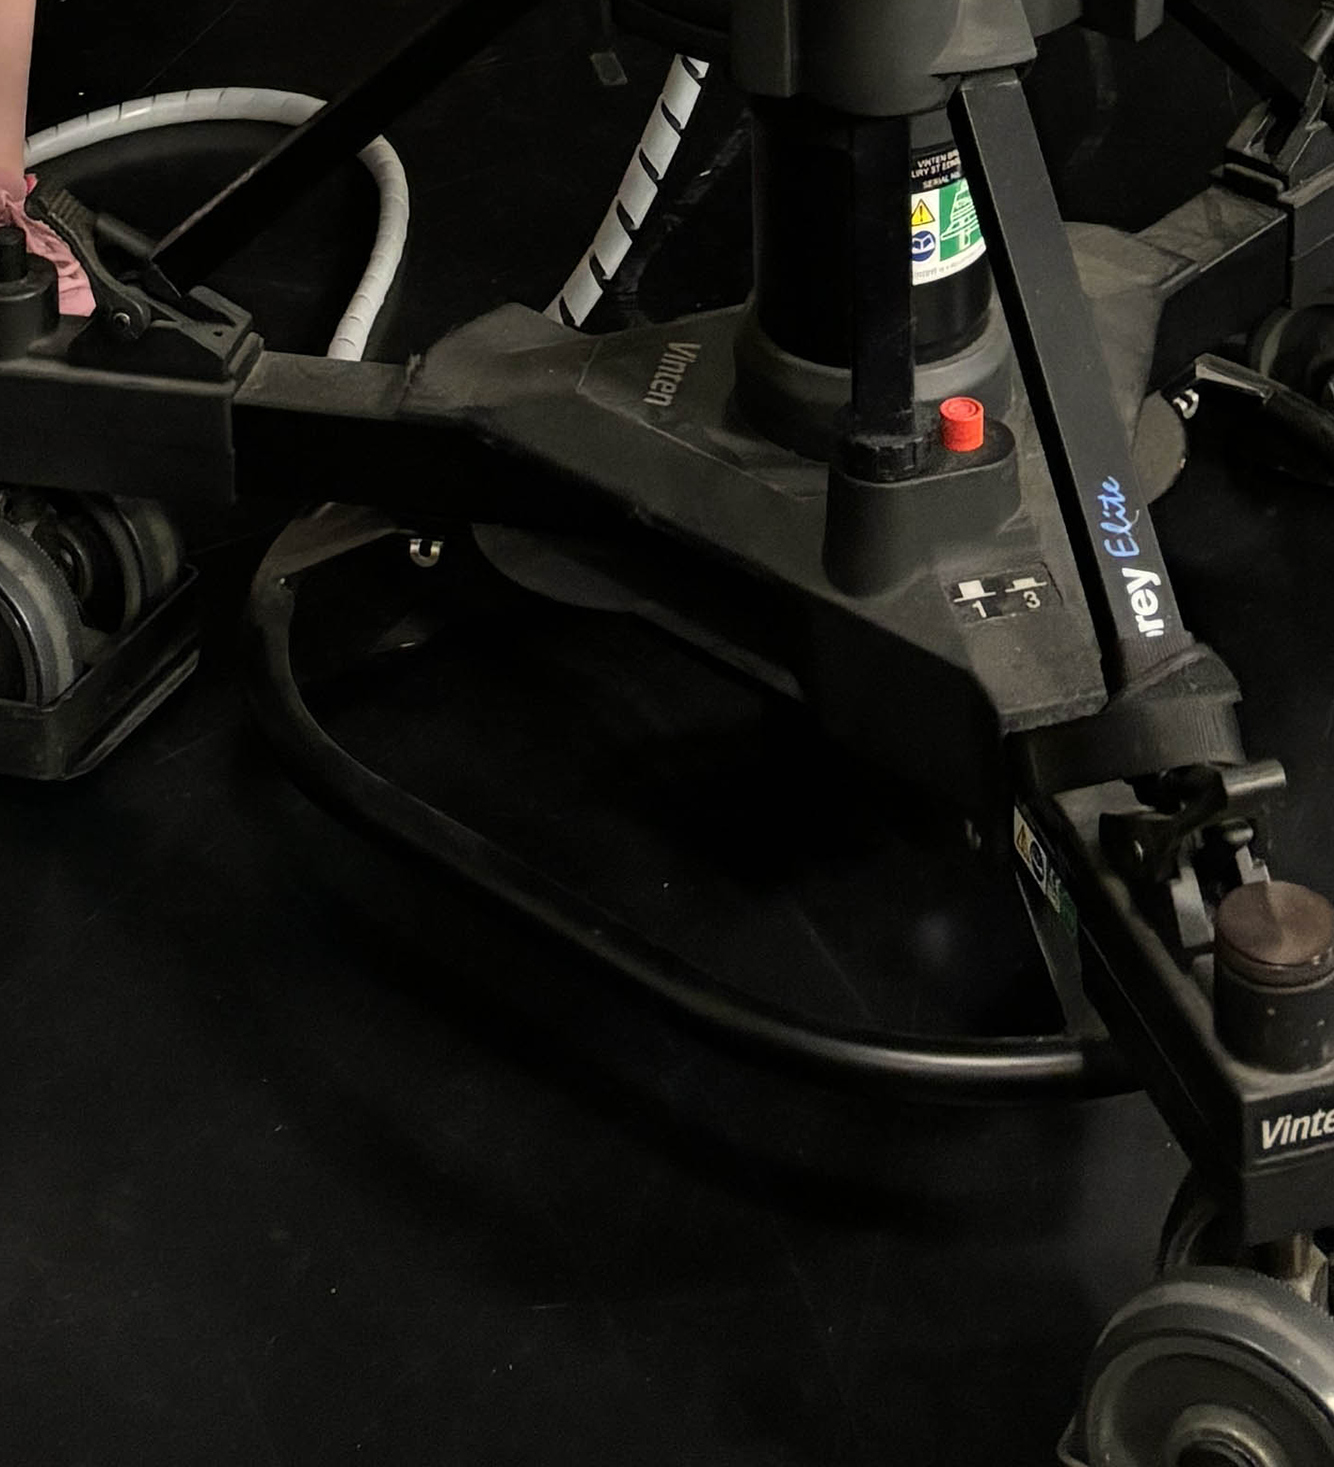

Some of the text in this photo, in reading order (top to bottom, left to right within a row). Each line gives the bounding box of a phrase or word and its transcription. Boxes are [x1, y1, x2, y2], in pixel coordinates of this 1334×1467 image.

[643, 342, 703, 407] Vinten
[1097, 475, 1165, 638] rey Elite
[972, 590, 1041, 619] 1 3
